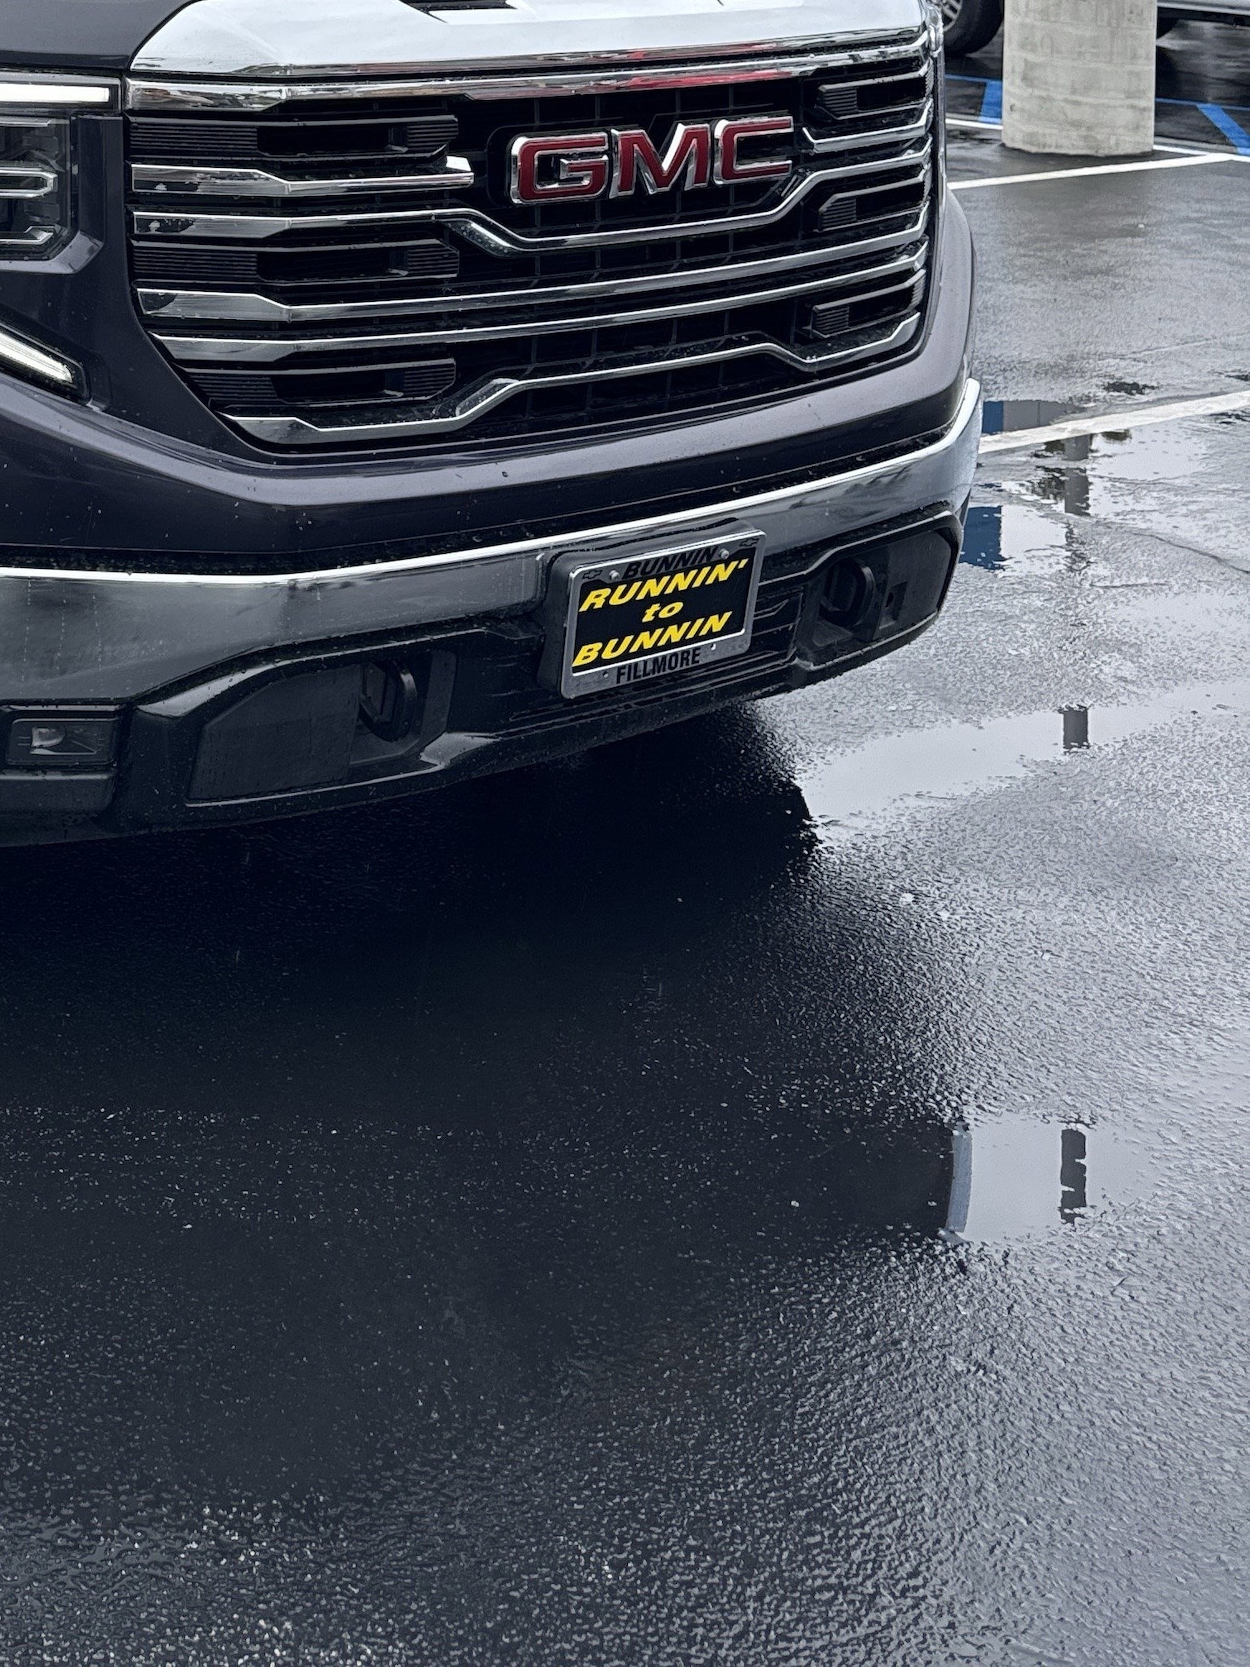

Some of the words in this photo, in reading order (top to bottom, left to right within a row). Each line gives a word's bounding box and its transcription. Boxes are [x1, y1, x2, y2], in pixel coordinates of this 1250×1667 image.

[509, 115, 795, 204] GMC
[578, 557, 750, 613] RUNNIN'
[622, 545, 719, 579] BUNNIN
[641, 601, 684, 623] to
[571, 610, 733, 668] BUNNIN
[615, 648, 701, 685] FILLMORE
